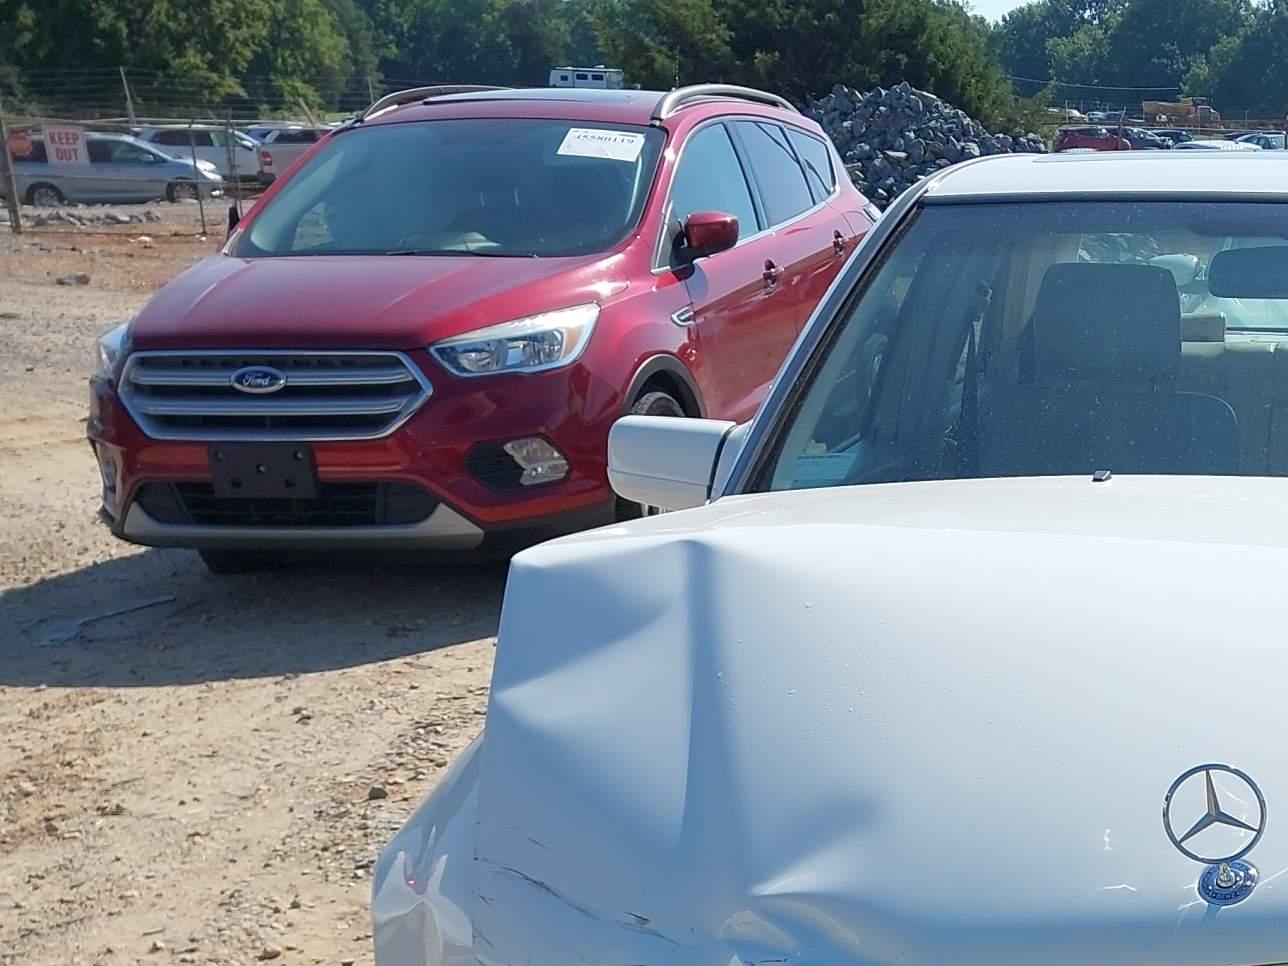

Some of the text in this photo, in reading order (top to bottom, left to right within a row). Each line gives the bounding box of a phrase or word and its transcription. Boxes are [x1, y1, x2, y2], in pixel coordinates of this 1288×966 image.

[48, 131, 80, 145] KEEP
[55, 148, 79, 161] OUT
[242, 374, 271, 386] Ford
